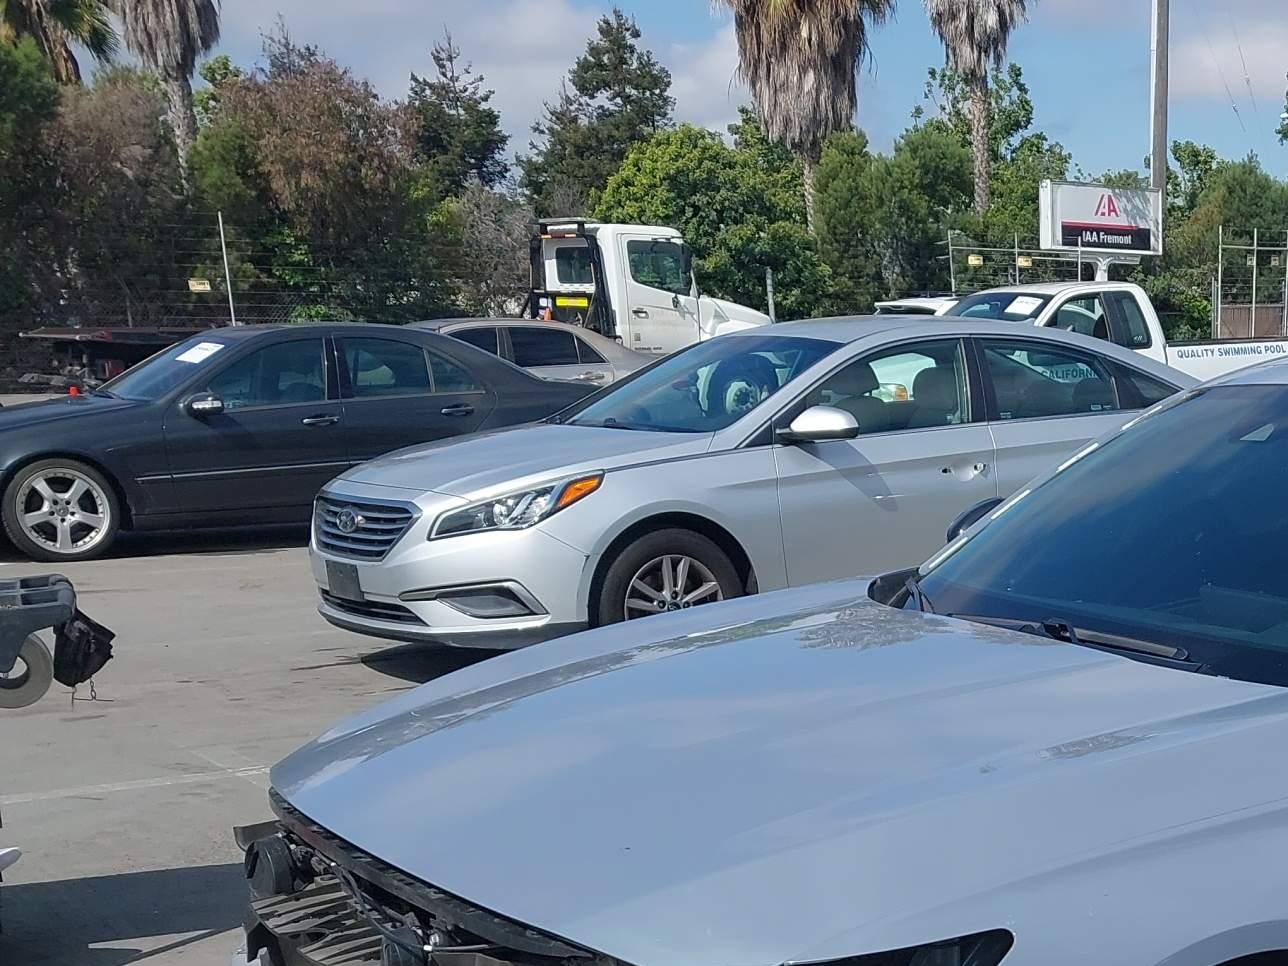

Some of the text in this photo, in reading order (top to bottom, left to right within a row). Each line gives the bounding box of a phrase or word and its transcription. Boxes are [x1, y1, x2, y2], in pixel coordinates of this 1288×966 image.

[1082, 230, 1132, 245] IAA Fremont
[1177, 348, 1215, 359] QUALITY
[1217, 345, 1262, 357] SWIMMING
[1264, 343, 1286, 354] POOL
